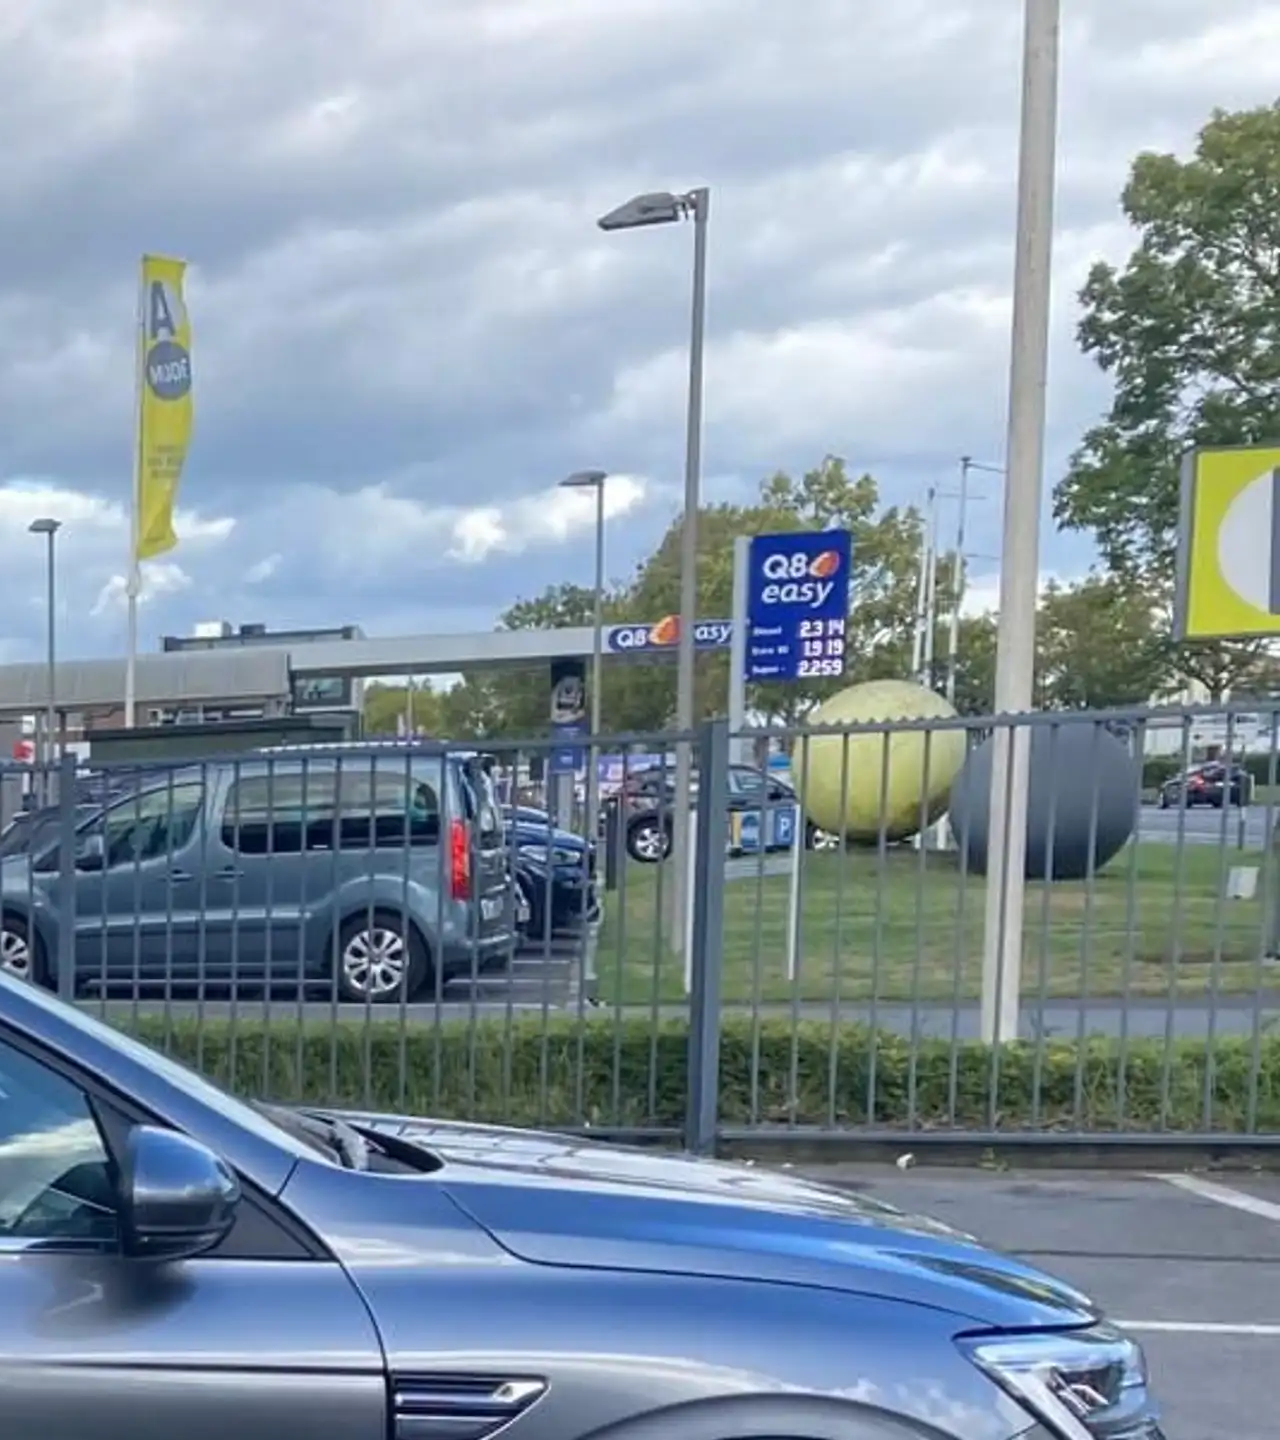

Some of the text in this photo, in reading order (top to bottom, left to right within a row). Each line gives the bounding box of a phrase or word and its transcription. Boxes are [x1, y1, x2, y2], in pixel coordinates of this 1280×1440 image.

[150, 280, 175, 338] A
[762, 552, 809, 580] Q8
[761, 581, 835, 609] easy
[616, 628, 648, 648] Q8
[694, 624, 733, 643] asy
